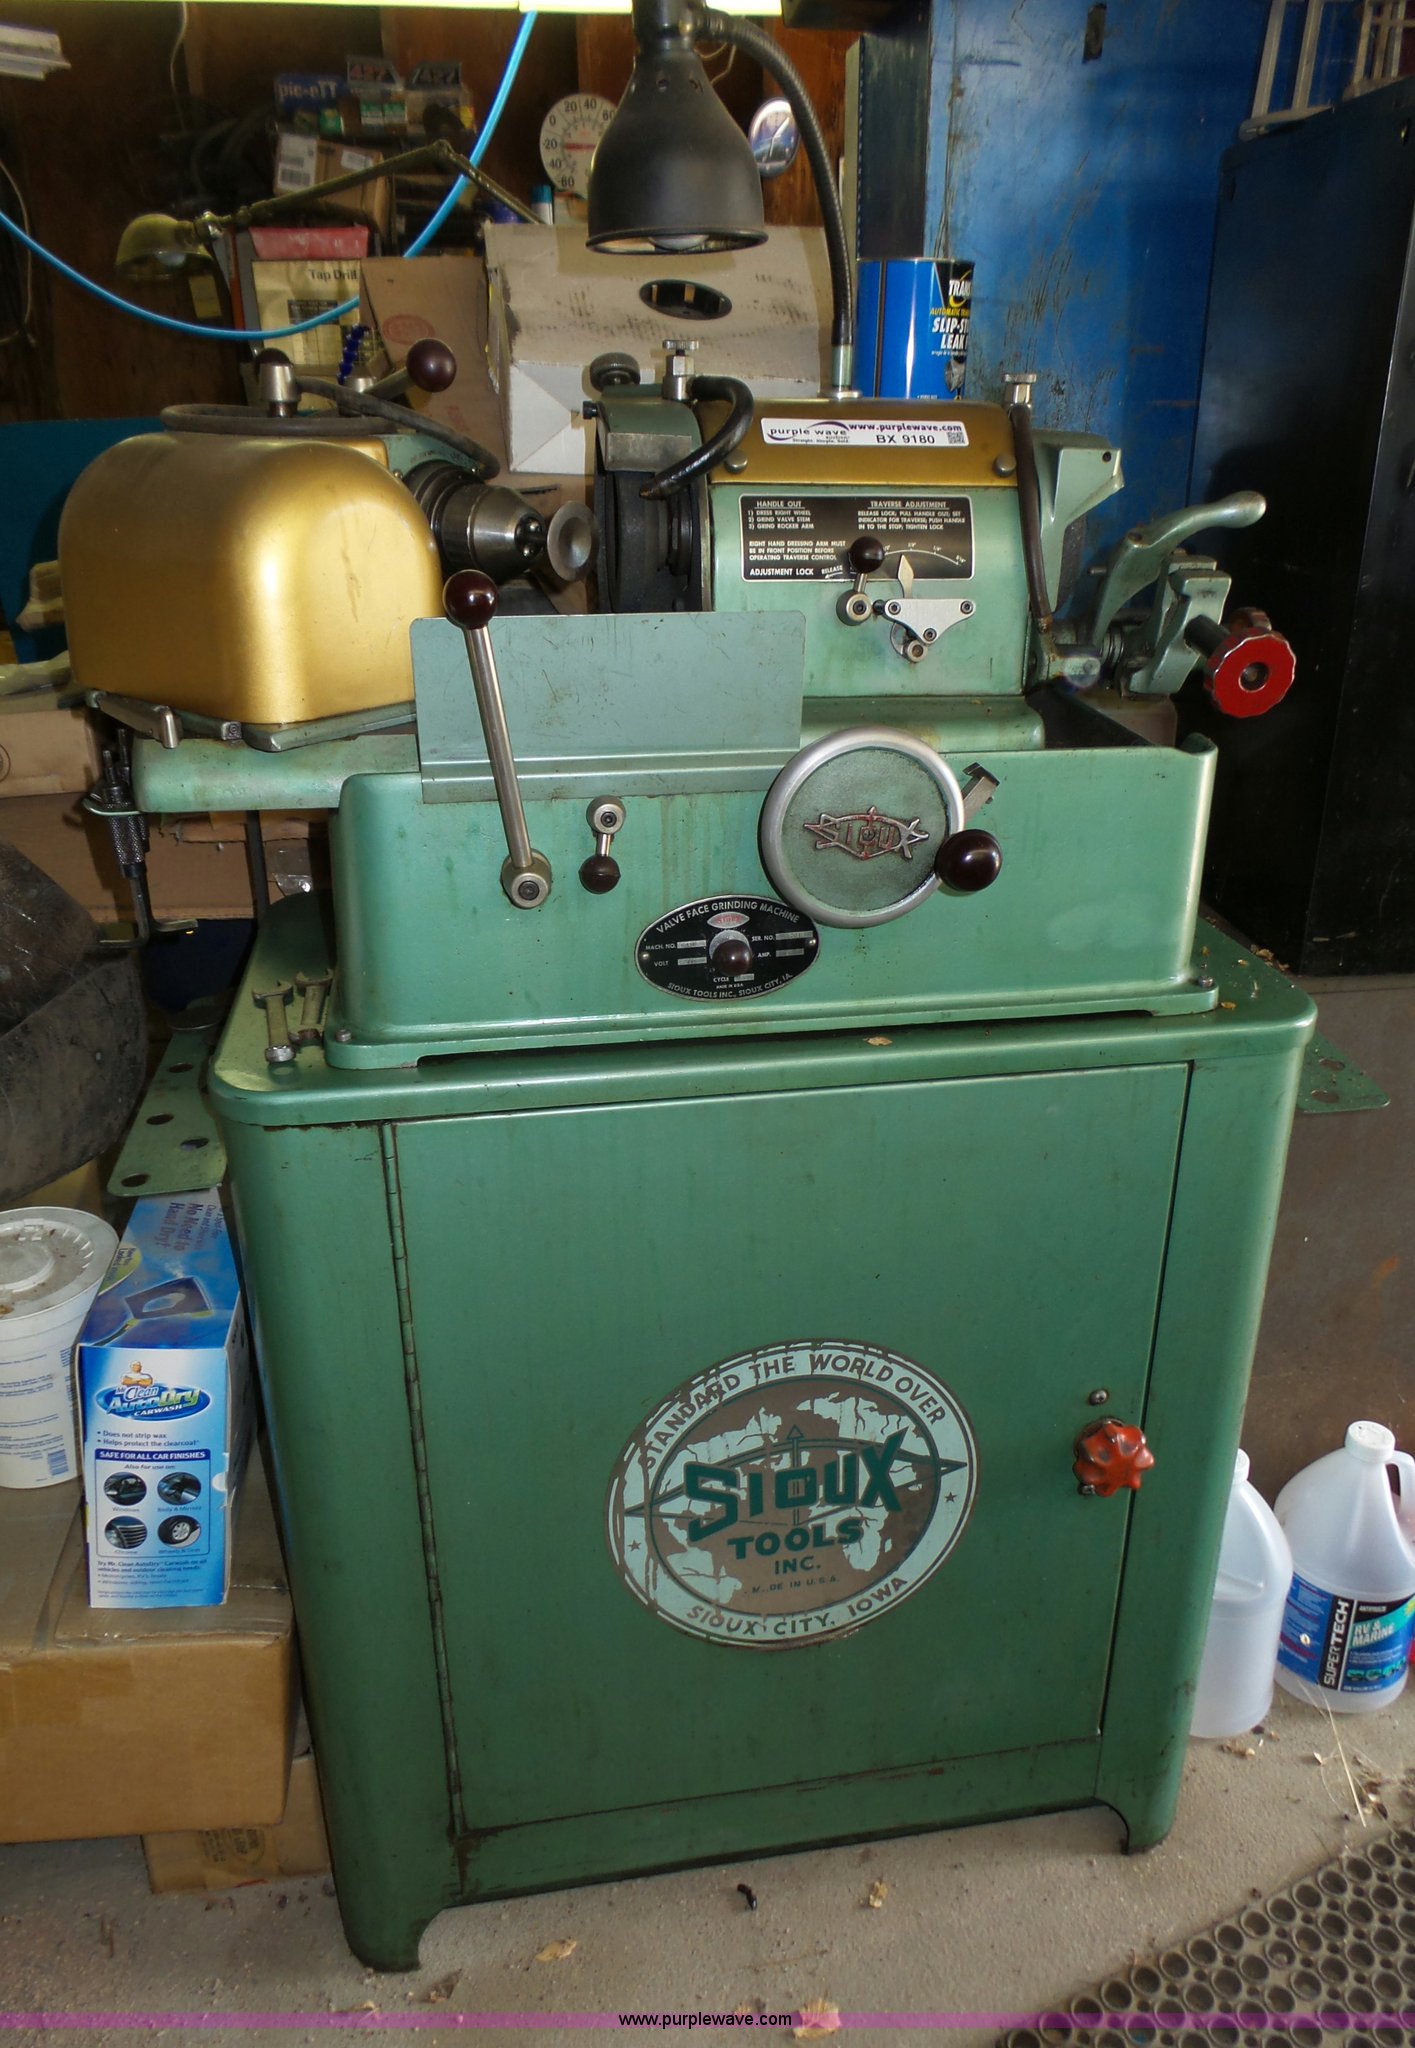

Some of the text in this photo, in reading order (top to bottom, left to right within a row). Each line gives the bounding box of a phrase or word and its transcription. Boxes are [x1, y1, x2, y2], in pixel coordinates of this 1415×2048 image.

[564, 101, 577, 112] 20
[584, 98, 597, 109] 40
[308, 268, 358, 283] Tap Drill
[770, 427, 810, 438] purple
[848, 422, 962, 433] www.purplewave.com
[875, 434, 935, 444] BX 9180
[749, 568, 814, 576] ADJUSTMENT LOCK
[821, 565, 843, 574] RELEASE
[655, 901, 800, 933] VALVE FACE GRINDING MACHINE
[667, 982, 692, 995] SIOUX
[693, 989, 718, 998] TOOLS
[738, 985, 763, 997] SIOUX
[123, 1386, 159, 1401] Clean
[134, 1404, 183, 1417] CARWASH
[638, 1353, 947, 1472] STANDARD THE WORLD OVER
[103, 1430, 120, 1438] Does
[135, 1432, 152, 1441] strip
[100, 1451, 119, 1459] SAFE
[136, 1452, 152, 1460] ALL
[152, 1452, 169, 1460] CAR
[170, 1451, 206, 1459] FINISHES
[684, 1425, 911, 1543] SIOUX
[727, 1517, 865, 1561] TOOLS
[774, 1555, 822, 1576] INC.
[751, 1582, 785, 1595] MDE
[790, 1579, 802, 1589] IN
[686, 1604, 765, 1637] SIOUX
[847, 1576, 909, 1618] IOWA
[1352, 1621, 1396, 1648] MARINE
